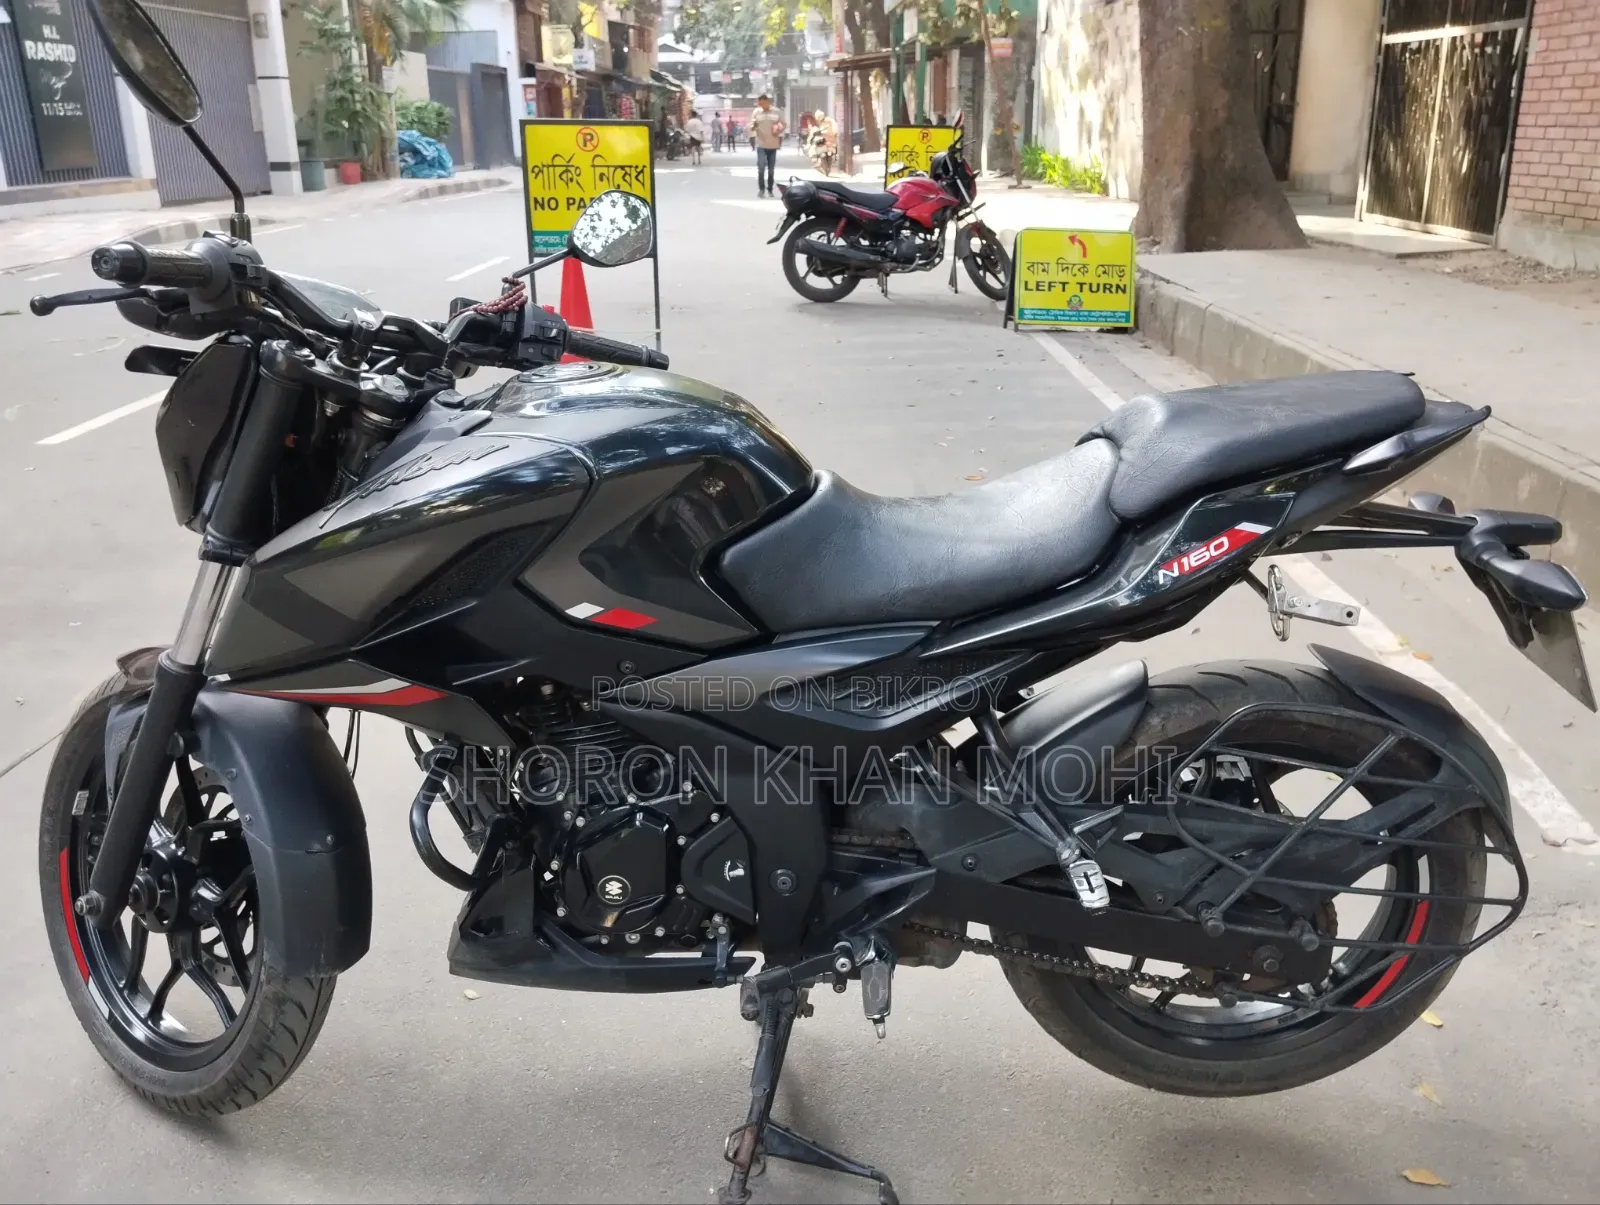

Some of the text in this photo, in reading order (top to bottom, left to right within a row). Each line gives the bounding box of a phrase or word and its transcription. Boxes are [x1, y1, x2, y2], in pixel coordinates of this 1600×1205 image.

[24, 40, 77, 63] RASHID
[531, 153, 647, 192] পার্কিং নিষেধ
[533, 197, 559, 211] NO
[1026, 257, 1127, 281] বাম দিকে মোড়
[1024, 280, 1127, 294] LEFT TURN
[1158, 536, 1230, 585] N160
